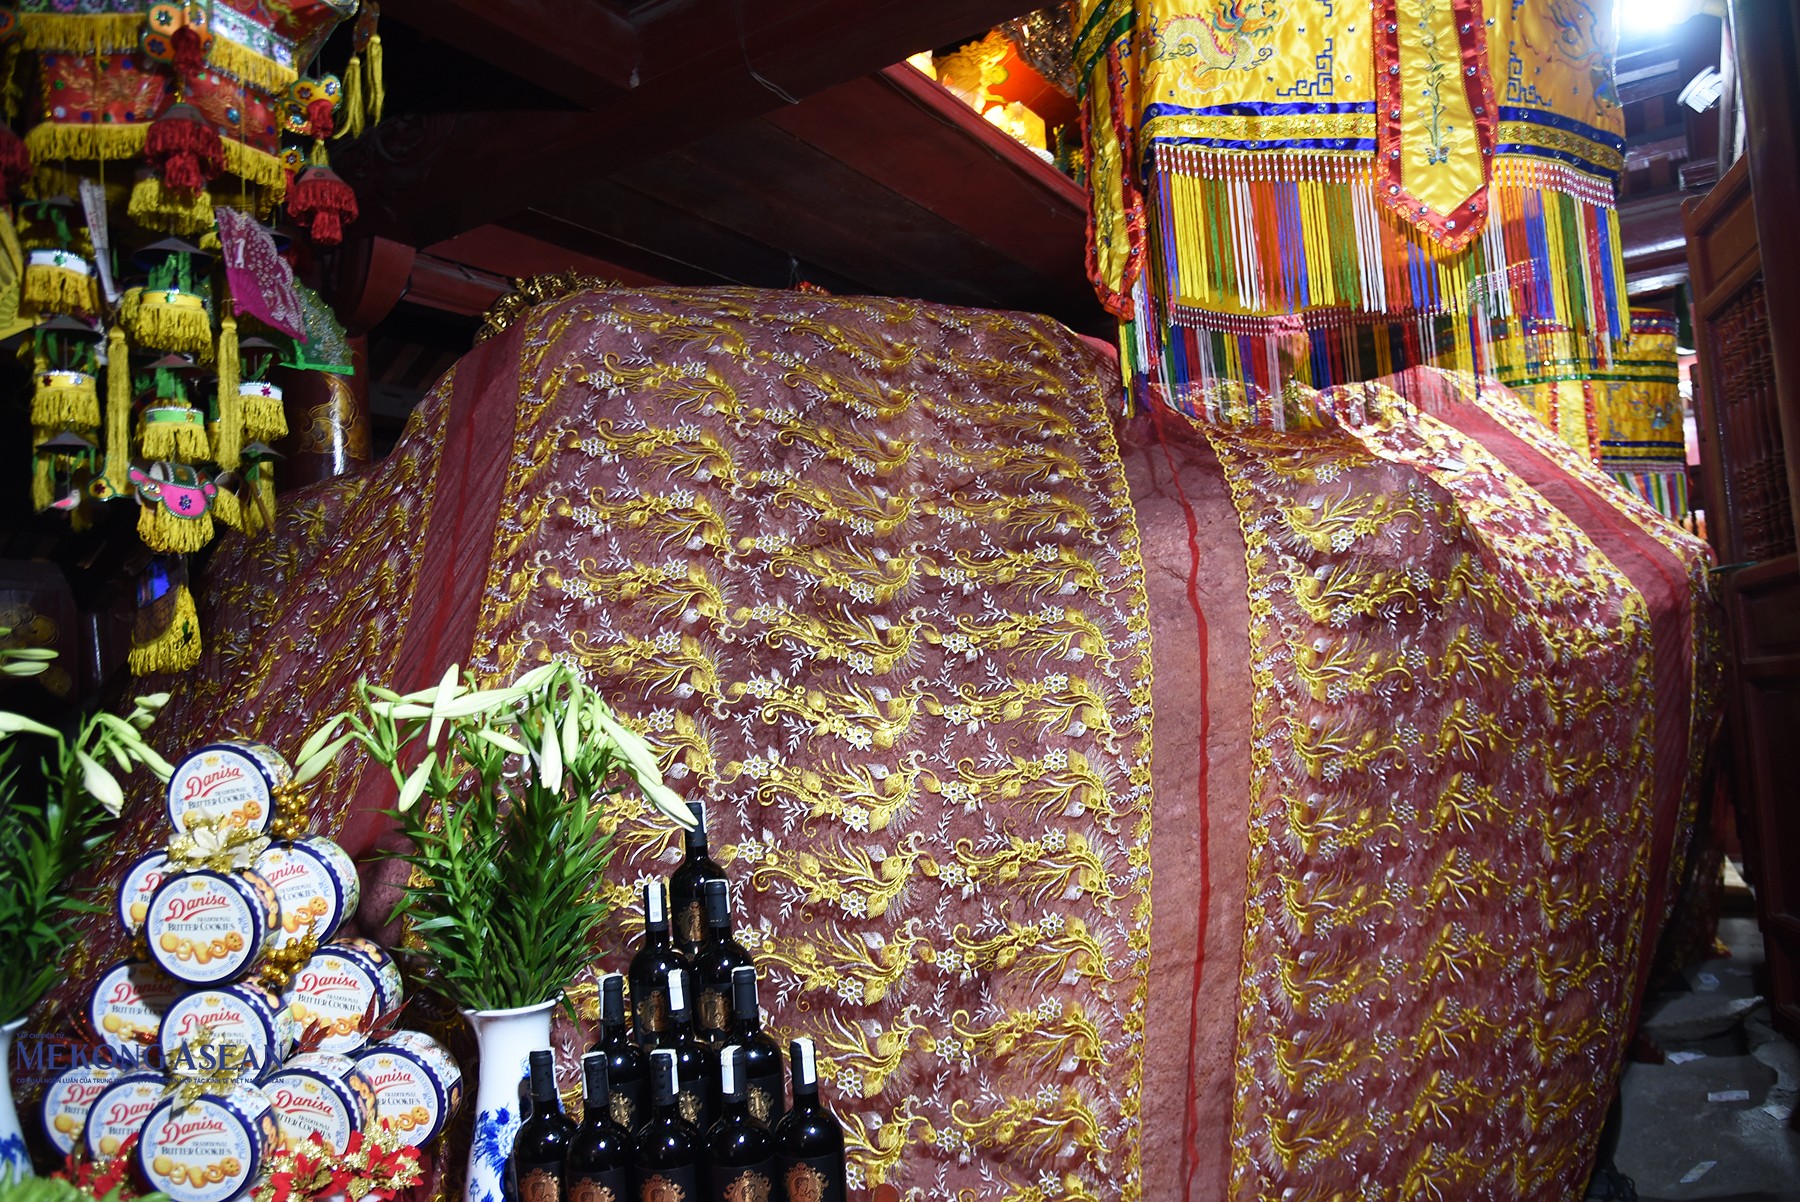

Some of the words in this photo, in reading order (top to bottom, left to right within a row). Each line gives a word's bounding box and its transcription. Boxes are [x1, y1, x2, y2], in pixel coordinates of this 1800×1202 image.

[184, 765, 244, 800] Danisa
[188, 799, 217, 810] BUTTER
[218, 793, 252, 805] COOKIES
[267, 862, 309, 888] anisa
[164, 891, 230, 922] Danisa
[282, 889, 318, 901] COOKIES
[168, 923, 198, 932] BUTTER
[200, 922, 236, 932] COOKIES
[109, 981, 176, 1005] Danisa
[296, 972, 360, 995] Danisa
[112, 1004, 142, 1014] BUTTER
[298, 994, 327, 1007] BUTTER
[328, 1000, 362, 1013] COOKIES
[177, 1007, 244, 1036] Danisa
[368, 1068, 415, 1094] anisa
[62, 1084, 105, 1106] Dan
[272, 1090, 334, 1117] Danisa
[387, 1097, 421, 1106] COOKIES
[64, 1105, 88, 1115] BUTT
[105, 1098, 156, 1126] Dani
[158, 1116, 227, 1145] Danisa
[161, 1147, 194, 1155] BUTTER
[194, 1147, 232, 1155] COOKIES
